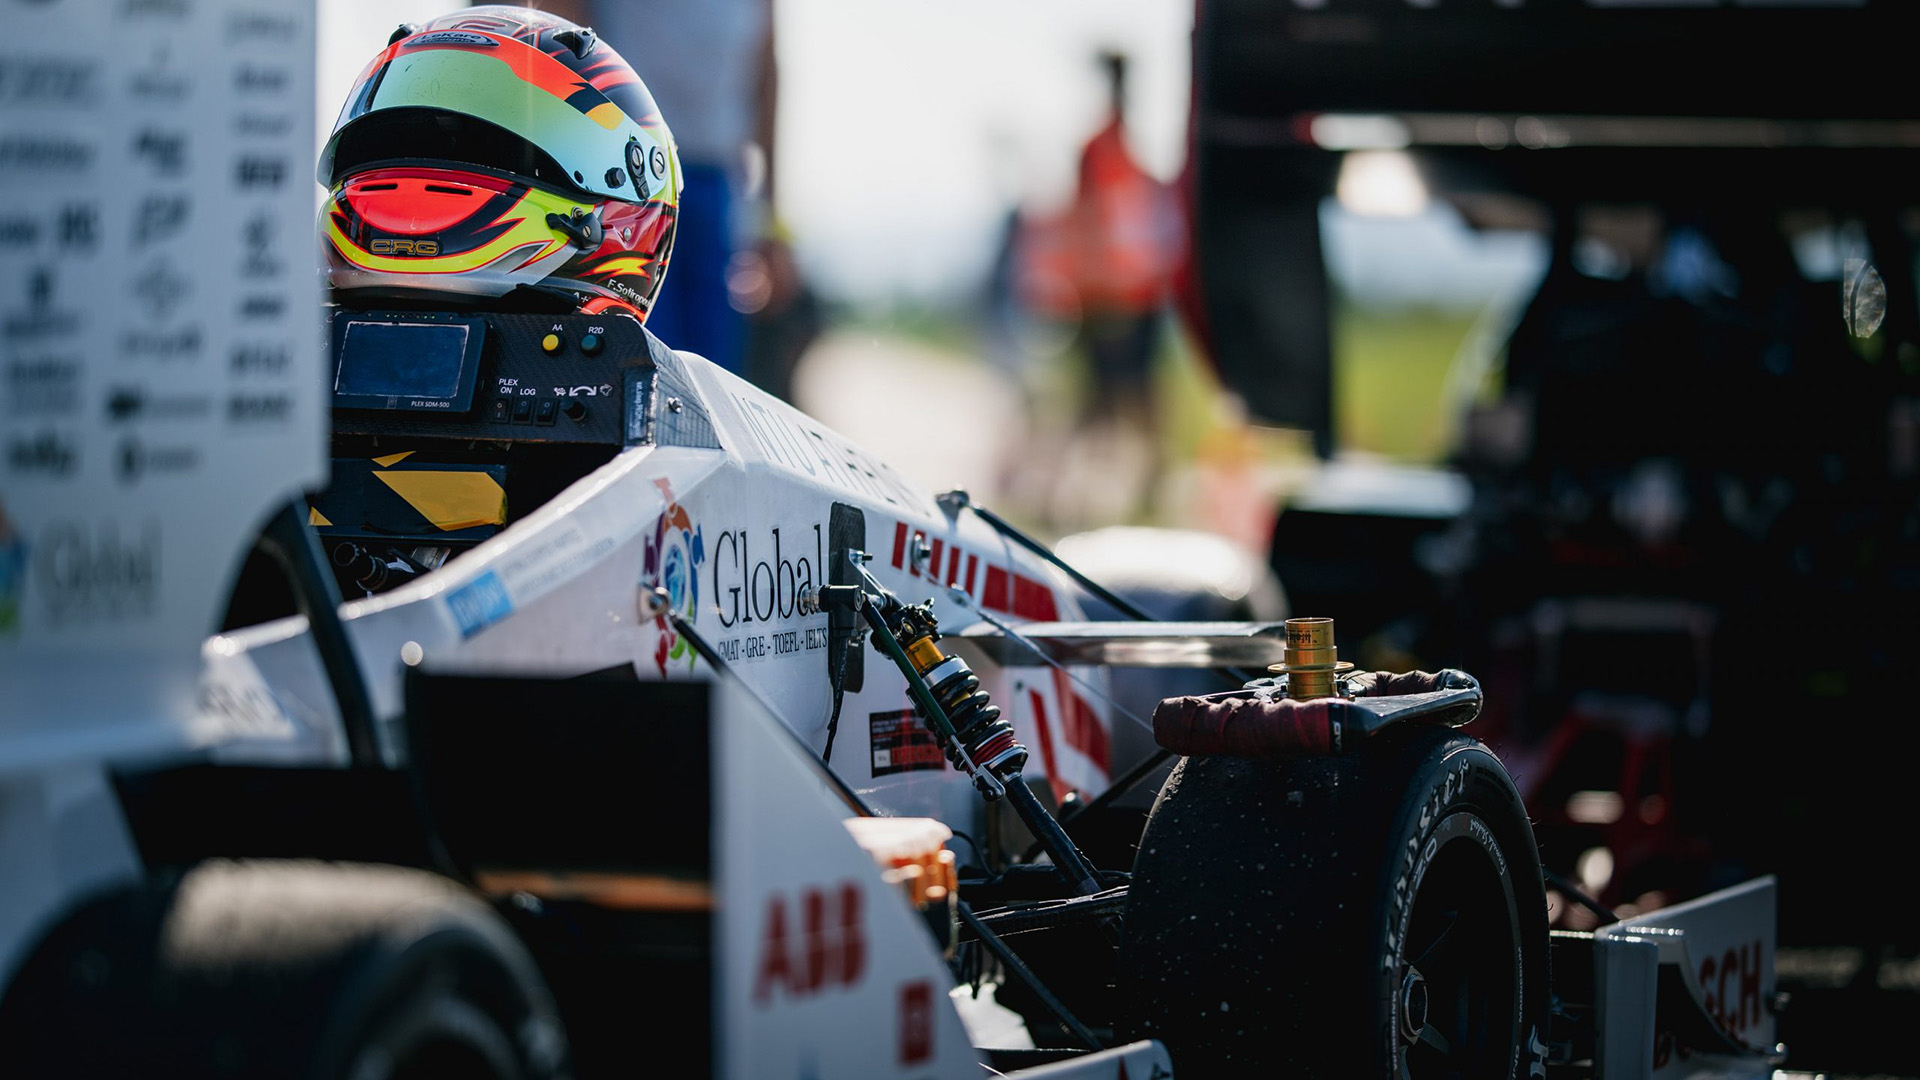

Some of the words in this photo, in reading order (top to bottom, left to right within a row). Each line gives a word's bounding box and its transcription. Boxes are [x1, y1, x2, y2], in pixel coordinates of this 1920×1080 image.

[371, 239, 439, 256] CRG
[551, 324, 563, 332] AA
[588, 326, 604, 334] R2D
[498, 378, 519, 387] PLEX
[500, 386, 513, 395] ON
[519, 388, 536, 396] LOG
[410, 400, 425, 408] PLEX
[730, 391, 816, 477] NTU
[714, 523, 825, 628] Global
[746, 636, 765, 658] GRE
[772, 631, 800, 655] TOEFL
[805, 627, 828, 651] IELTS
